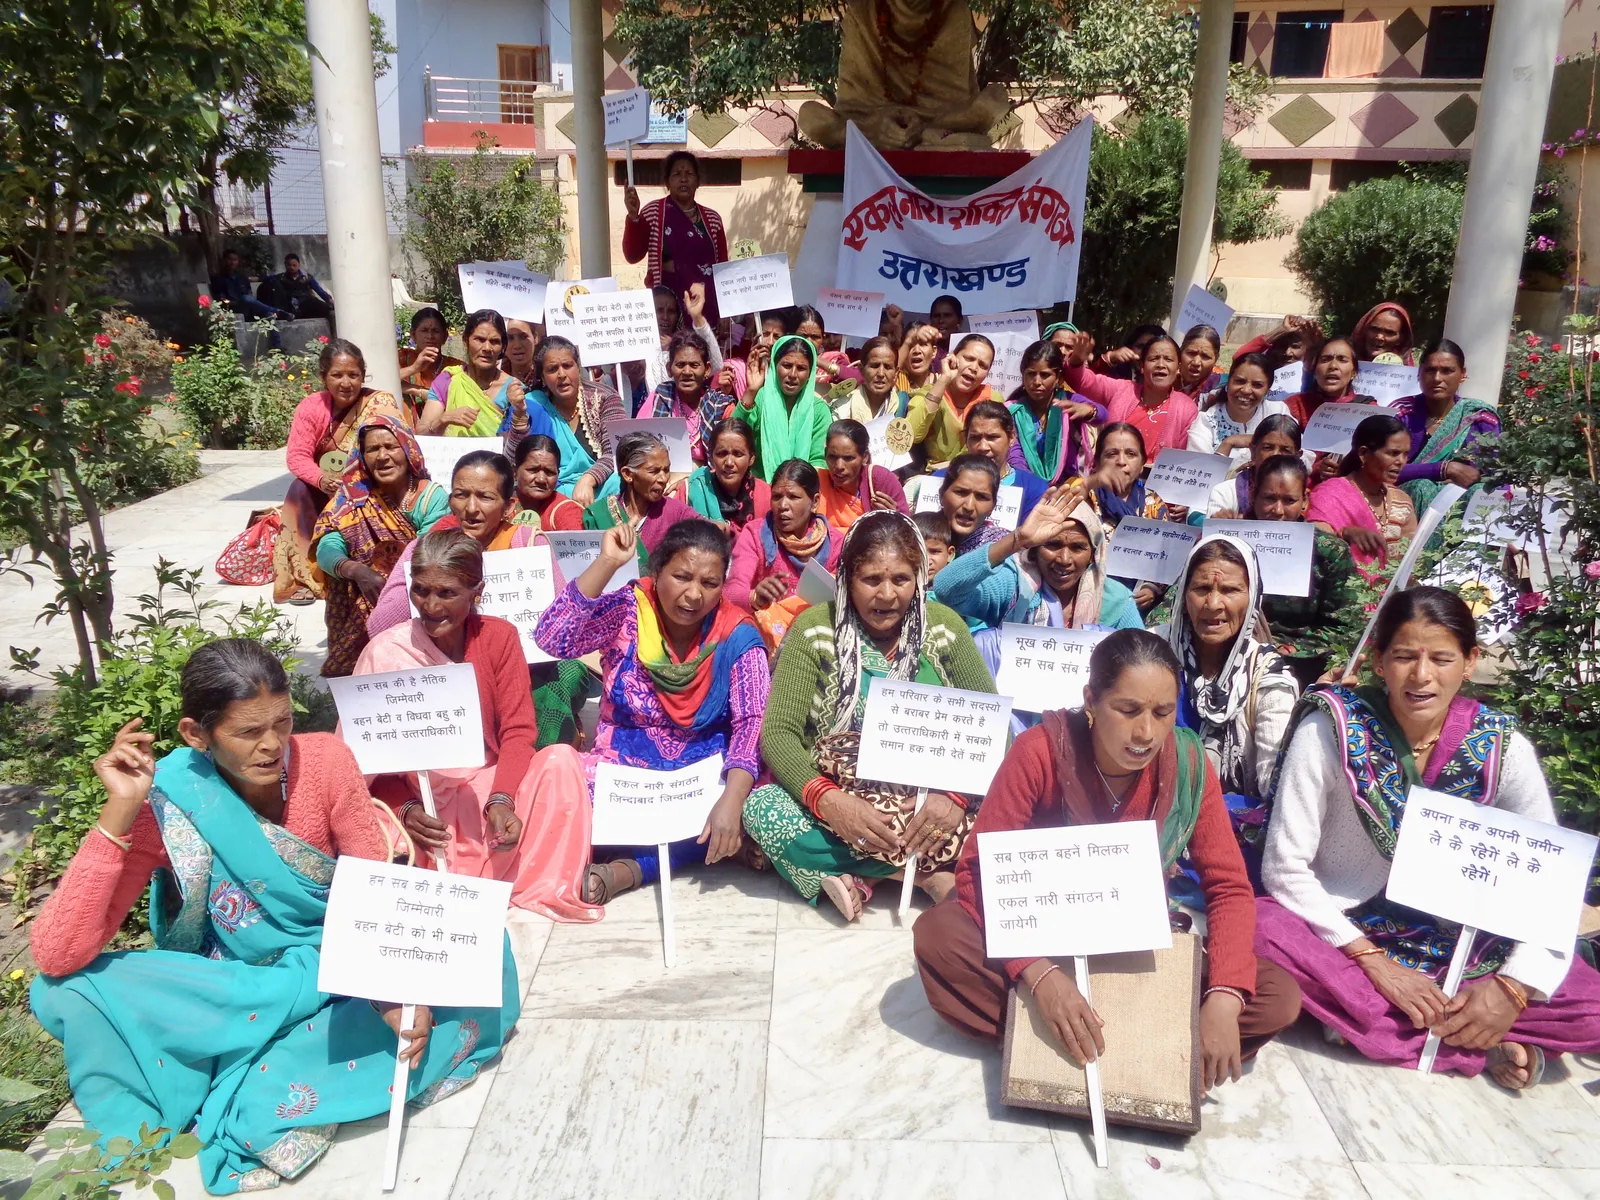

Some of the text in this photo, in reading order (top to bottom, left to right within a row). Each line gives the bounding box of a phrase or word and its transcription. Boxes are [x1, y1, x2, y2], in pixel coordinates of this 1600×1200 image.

[842, 185, 904, 252] एकल
[948, 185, 1026, 231] शक्ति
[1018, 177, 1075, 256] संगठन
[878, 250, 1031, 291] उत्तराखण्ड
[597, 304, 608, 312] बेटा
[610, 302, 621, 311] बेटी
[624, 301, 632, 310] को
[634, 301, 645, 310] एक
[580, 318, 597, 326] समान
[599, 316, 608, 324] प्रेम
[611, 314, 626, 323] करते
[635, 312, 654, 320] लेकिन
[586, 330, 603, 338] जमीन
[634, 325, 652, 333] बराबर
[587, 341, 611, 350] अधिकार
[613, 340, 625, 348] नही
[1006, 505, 1017, 514] का
[1122, 525, 1139, 533] एकल
[1140, 527, 1152, 535] नारी
[1153, 527, 1160, 536] के
[1243, 529, 1260, 539] नारी
[1264, 530, 1291, 541] संगठन
[579, 551, 591, 560] नही
[1122, 546, 1143, 556] बदलाव
[1255, 543, 1293, 555] जिन्दाबाद
[529, 568, 546, 579] यह
[498, 591, 520, 603] शान
[525, 587, 533, 600] है
[1016, 637, 1084, 655] भूख की जंग
[1015, 656, 1032, 668] हम
[1037, 659, 1055, 672] सब
[356, 673, 448, 693] हम सब की है नैतिक
[385, 691, 425, 706] जिम्मेवारी
[881, 687, 894, 697] हम
[899, 689, 929, 703] परिवार
[933, 693, 942, 704] के
[947, 696, 966, 708] सभी
[352, 705, 466, 727] बहन बेटी व विधवा बहु को
[890, 704, 986, 727] से बराबर प्रेम करते है
[361, 731, 372, 743] भी
[878, 720, 993, 747] तो उत्तराधिकारी में सबको
[880, 740, 904, 751] समान
[909, 743, 925, 754] हक
[929, 746, 946, 758] नही
[969, 750, 986, 763] क्यों
[613, 775, 700, 791] एकल नारी संगठन
[609, 788, 704, 805] जिन्दाबाद जिन्दाबाद
[1420, 807, 1565, 856] अपना हक अपनी जमीन
[993, 842, 1130, 864] सब एकल बहनें मिलकर
[1429, 829, 1443, 846] ले
[1449, 834, 1464, 852] के
[1506, 851, 1521, 869] ले
[1527, 857, 1542, 875] के
[995, 869, 1032, 885] आयेगी
[391, 877, 409, 891] सब
[415, 881, 430, 893] की
[435, 882, 444, 896] है
[449, 884, 480, 901] नैतिक
[998, 888, 1120, 910] एकल नारी संगठन में
[396, 897, 445, 918] जिम्मेवारी
[1000, 915, 1038, 930] जायेगी
[354, 920, 478, 946] बहन बेटी को भी बनाये
[378, 945, 449, 964] उत्तराधिकारी
